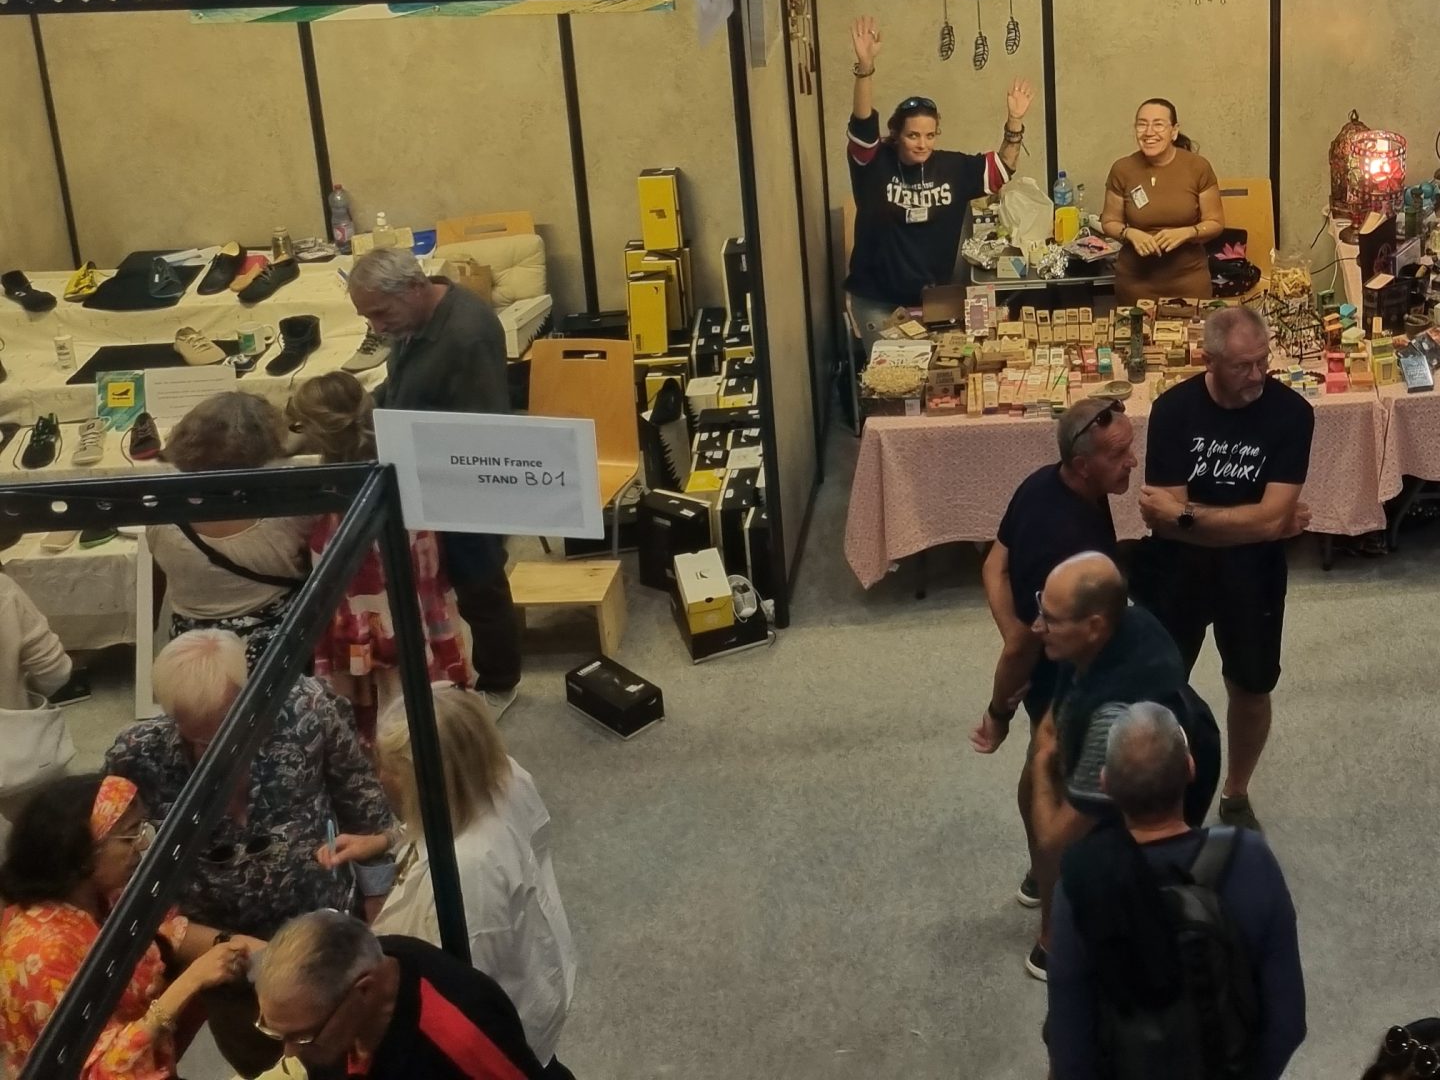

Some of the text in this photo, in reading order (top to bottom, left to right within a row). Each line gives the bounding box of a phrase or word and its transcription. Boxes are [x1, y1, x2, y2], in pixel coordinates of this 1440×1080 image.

[1190, 437, 1205, 453] Je
[1207, 440, 1229, 458] fais
[450, 455, 543, 468] DELPHIN France
[1187, 456, 1208, 482] je
[478, 474, 518, 485] STAND
